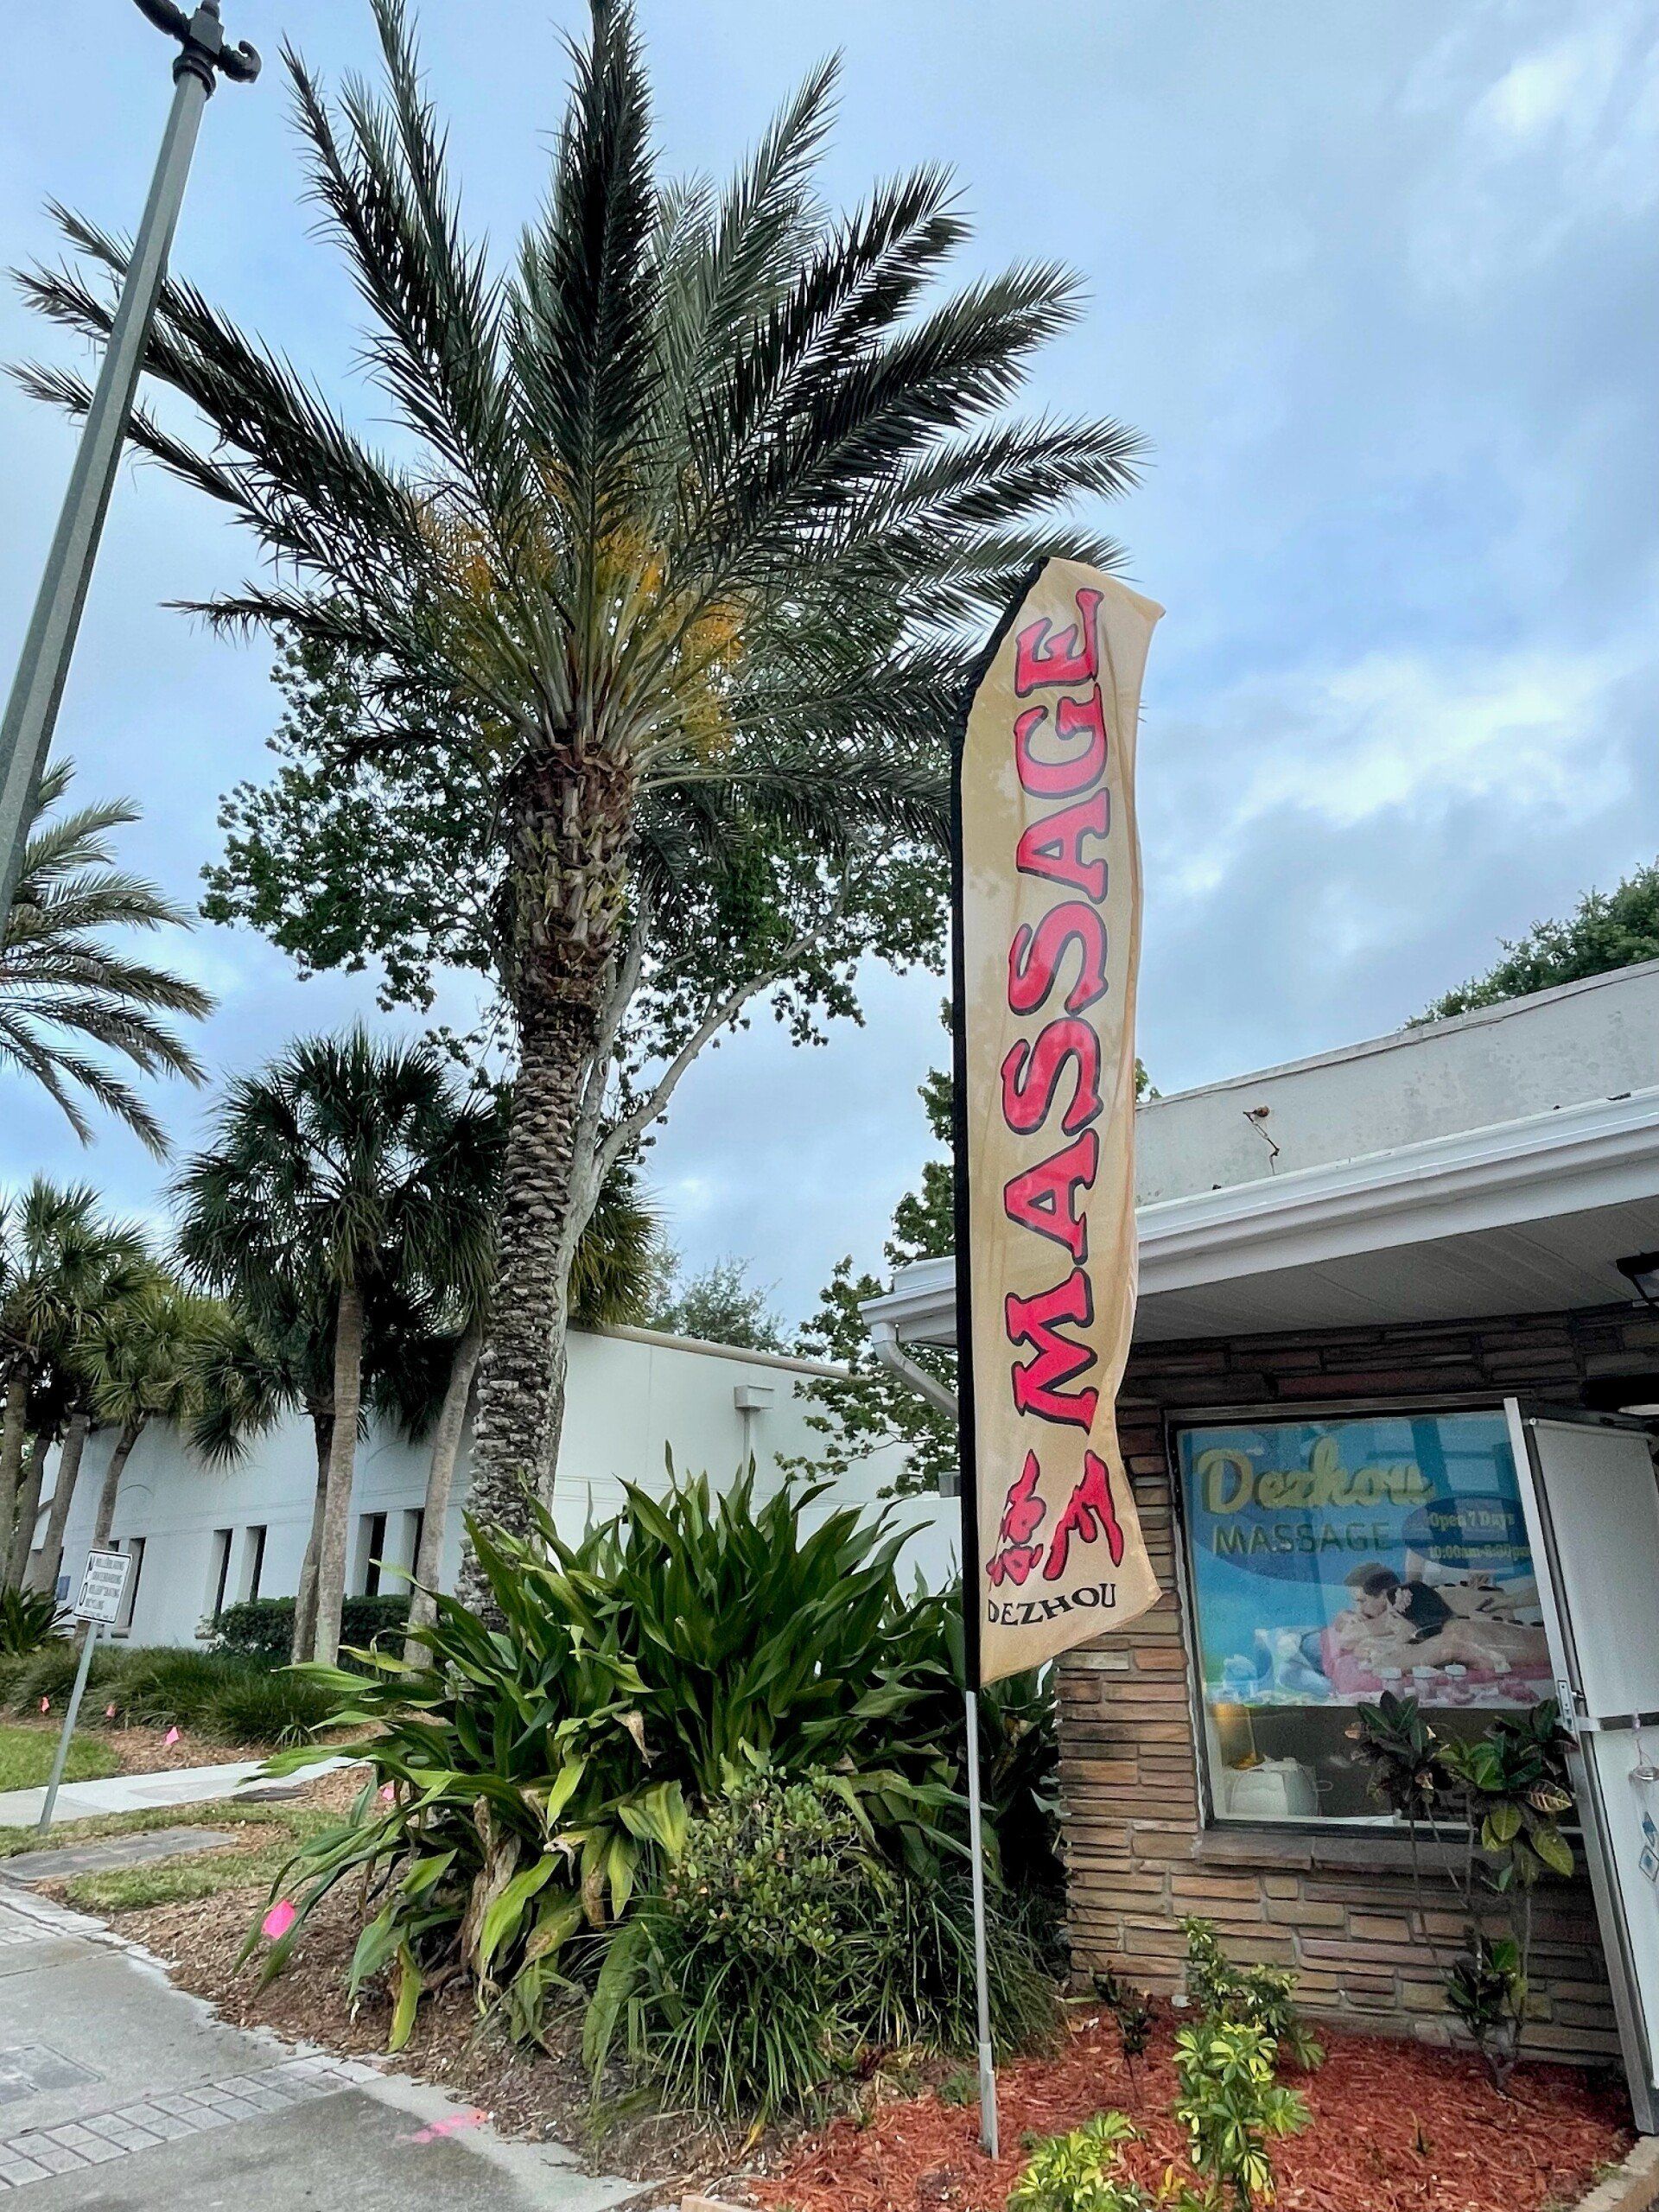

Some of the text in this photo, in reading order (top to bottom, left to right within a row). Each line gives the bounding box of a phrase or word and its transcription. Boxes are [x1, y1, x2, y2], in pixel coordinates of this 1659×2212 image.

[1001, 588, 1110, 1436] MASSAGE
[1213, 1522, 1393, 1554] MASSAGE
[1428, 1510, 1516, 1531] Open 7 Days
[988, 1583, 1116, 1625] DEZHOU
